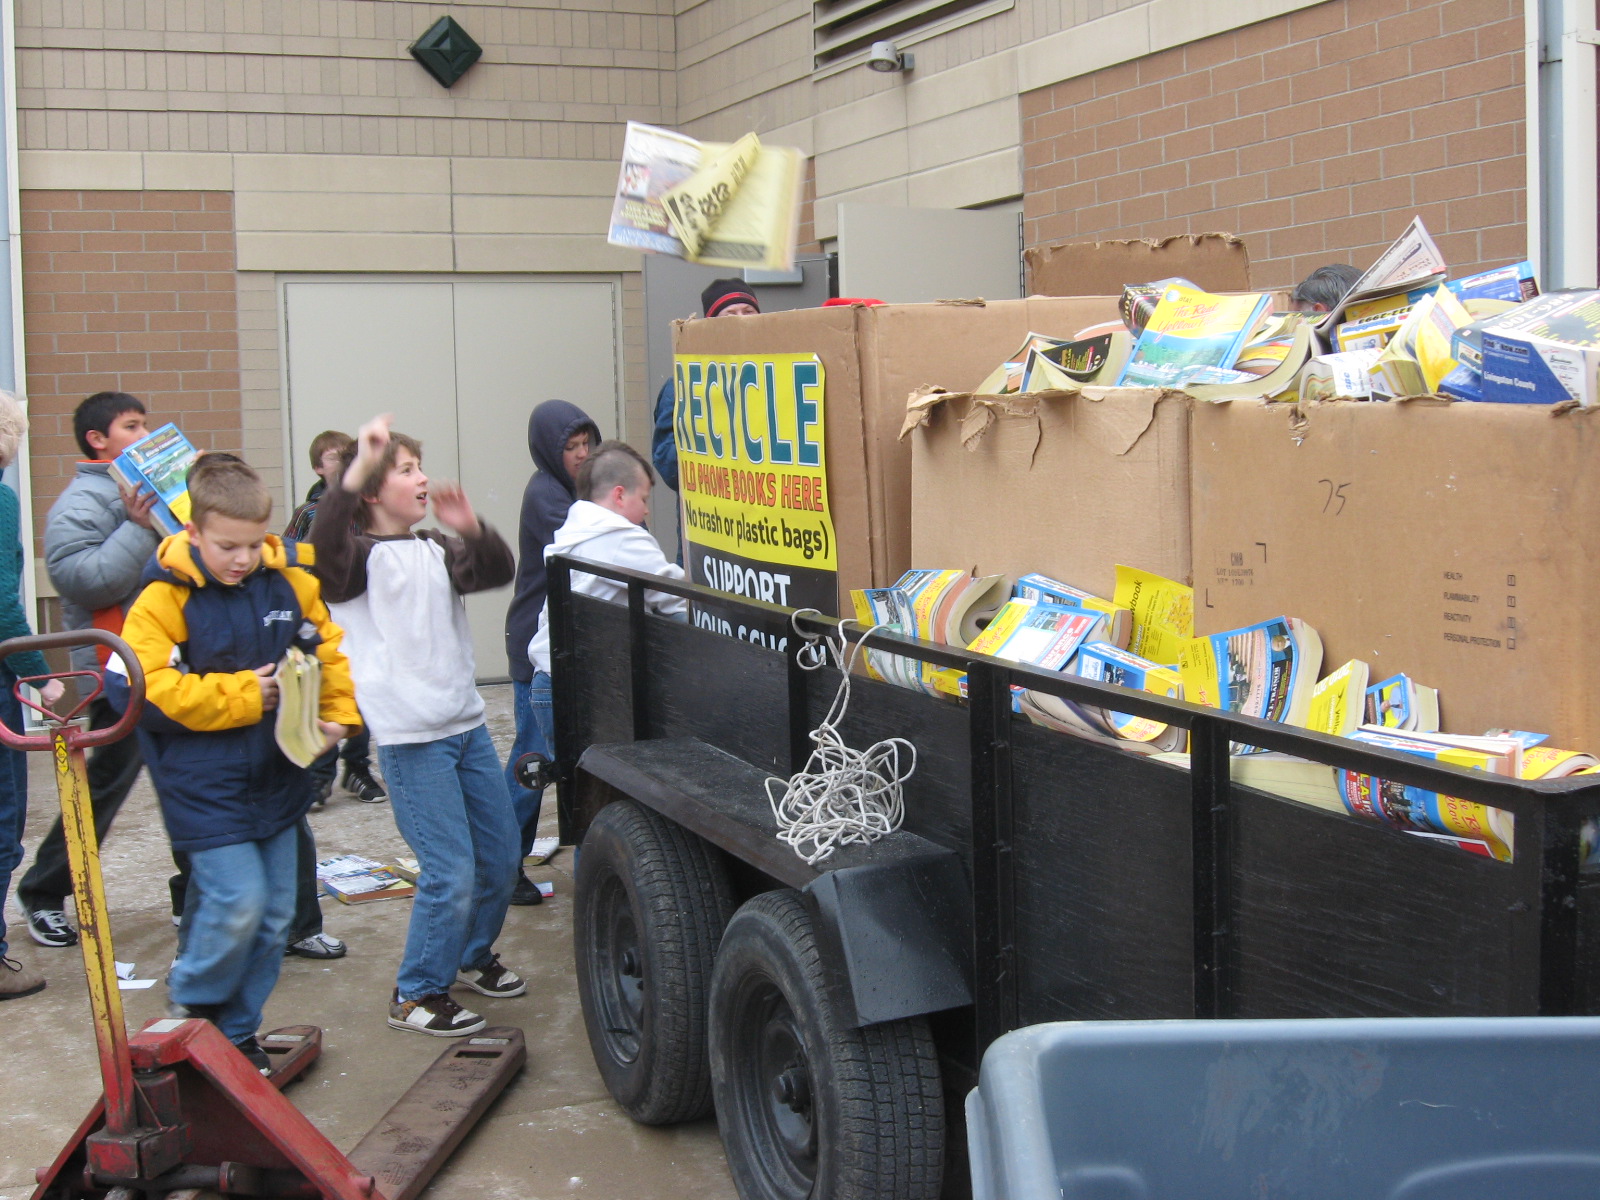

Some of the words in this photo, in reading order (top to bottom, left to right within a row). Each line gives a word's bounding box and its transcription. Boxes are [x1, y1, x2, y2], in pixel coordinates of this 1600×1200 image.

[1192, 302, 1220, 319] Real
[674, 361, 820, 467] RECYCLE
[699, 463, 731, 500] PHONE
[732, 469, 777, 507] BOOKS
[781, 474, 824, 512] HERE
[1318, 478, 1352, 516] 75
[698, 506, 723, 535] trash
[723, 517, 735, 538] or
[736, 513, 779, 548] plastic
[780, 517, 829, 560] bags)
[703, 555, 791, 607] SUPPORT
